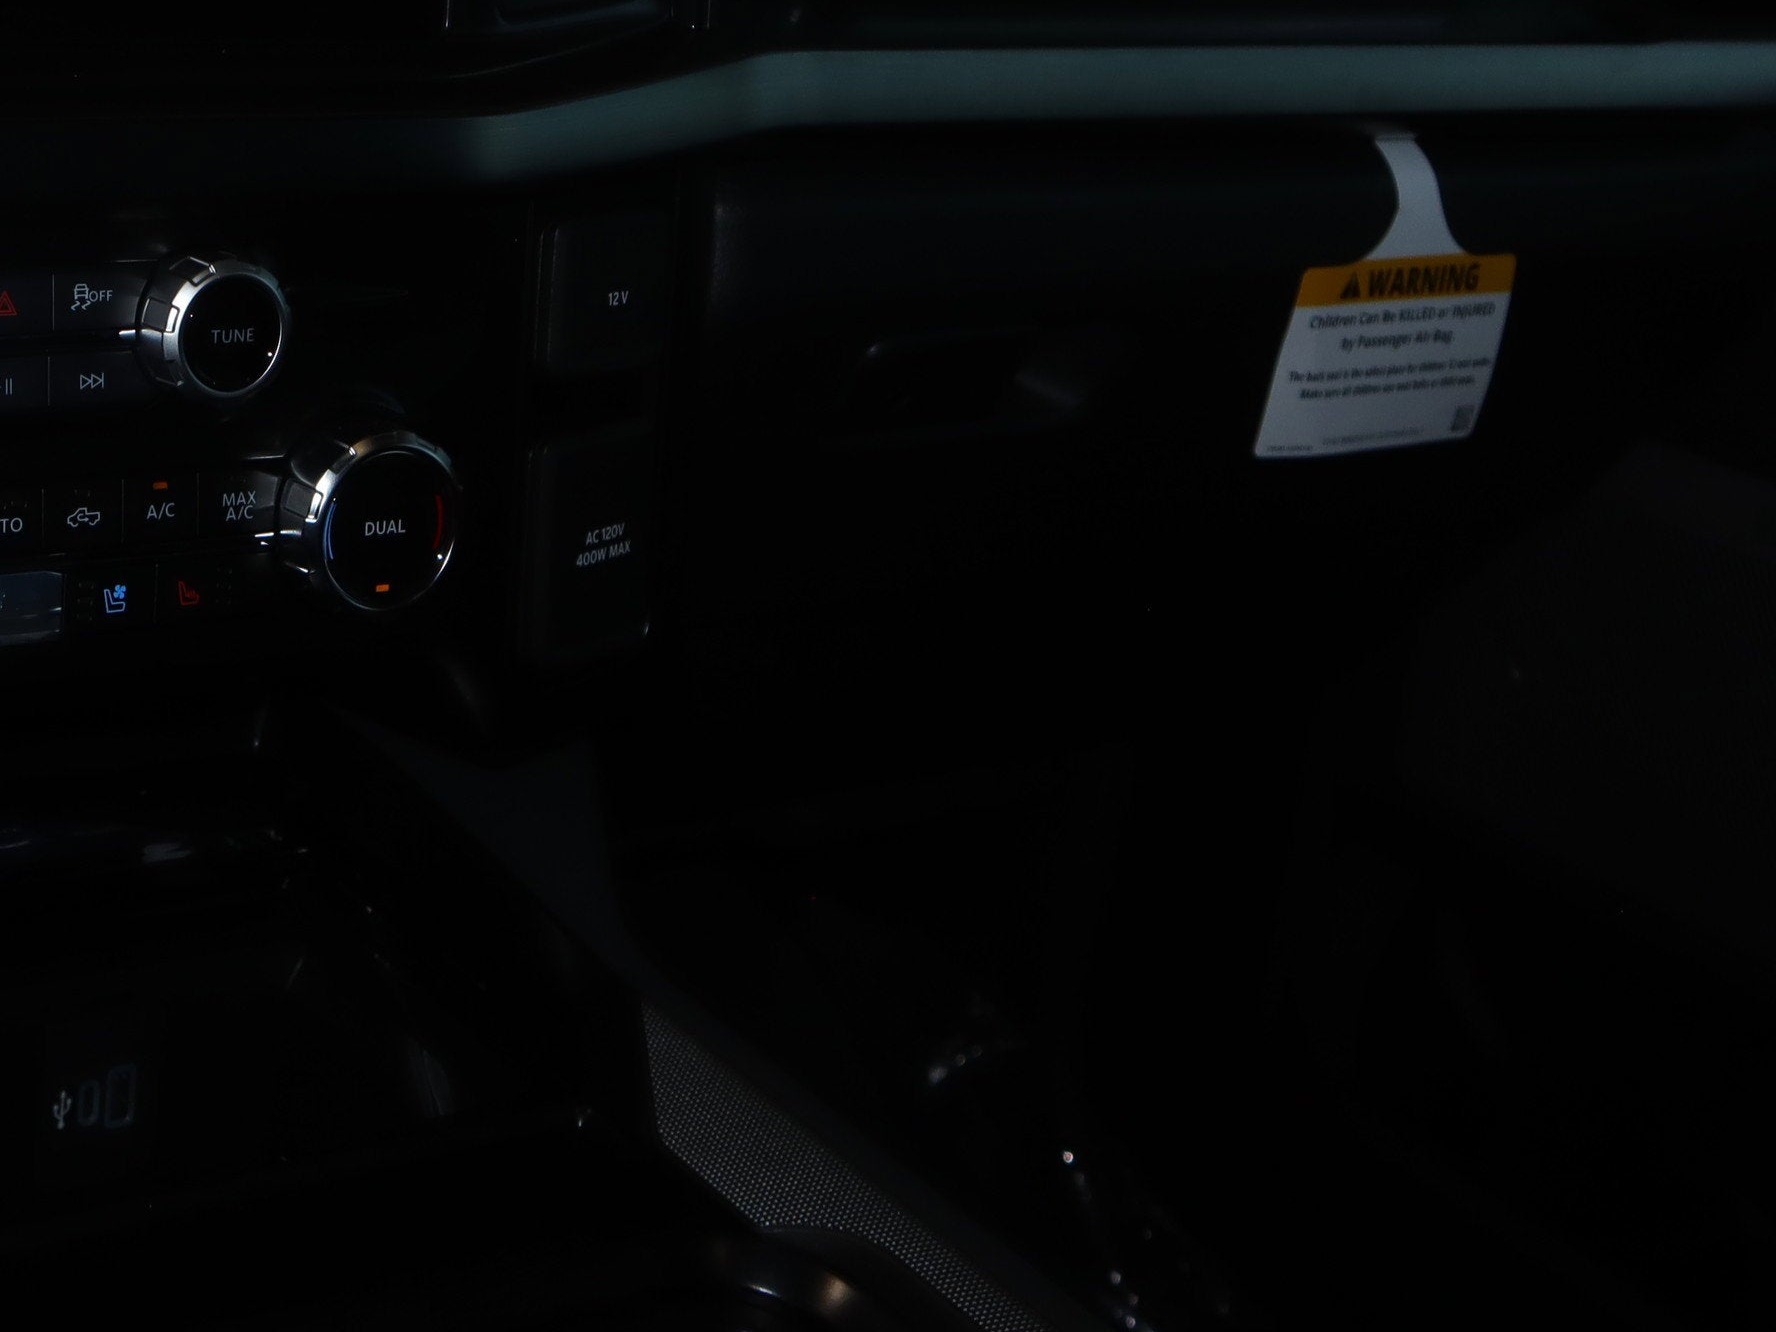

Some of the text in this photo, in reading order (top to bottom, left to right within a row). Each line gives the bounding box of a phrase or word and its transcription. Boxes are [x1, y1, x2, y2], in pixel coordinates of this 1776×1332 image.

[1368, 263, 1481, 298] WARNING
[87, 286, 114, 304] OFF
[1309, 312, 1356, 329] Children
[1398, 306, 1436, 321] KILLED
[210, 326, 256, 345] TUNE
[1358, 332, 1412, 351] Passenger
[222, 490, 257, 508] MAX
[145, 500, 176, 520] A/C
[225, 505, 254, 523] A/C
[363, 519, 407, 538] DUAL
[585, 522, 626, 547] AC 120V
[576, 539, 632, 568] 400W MAX
